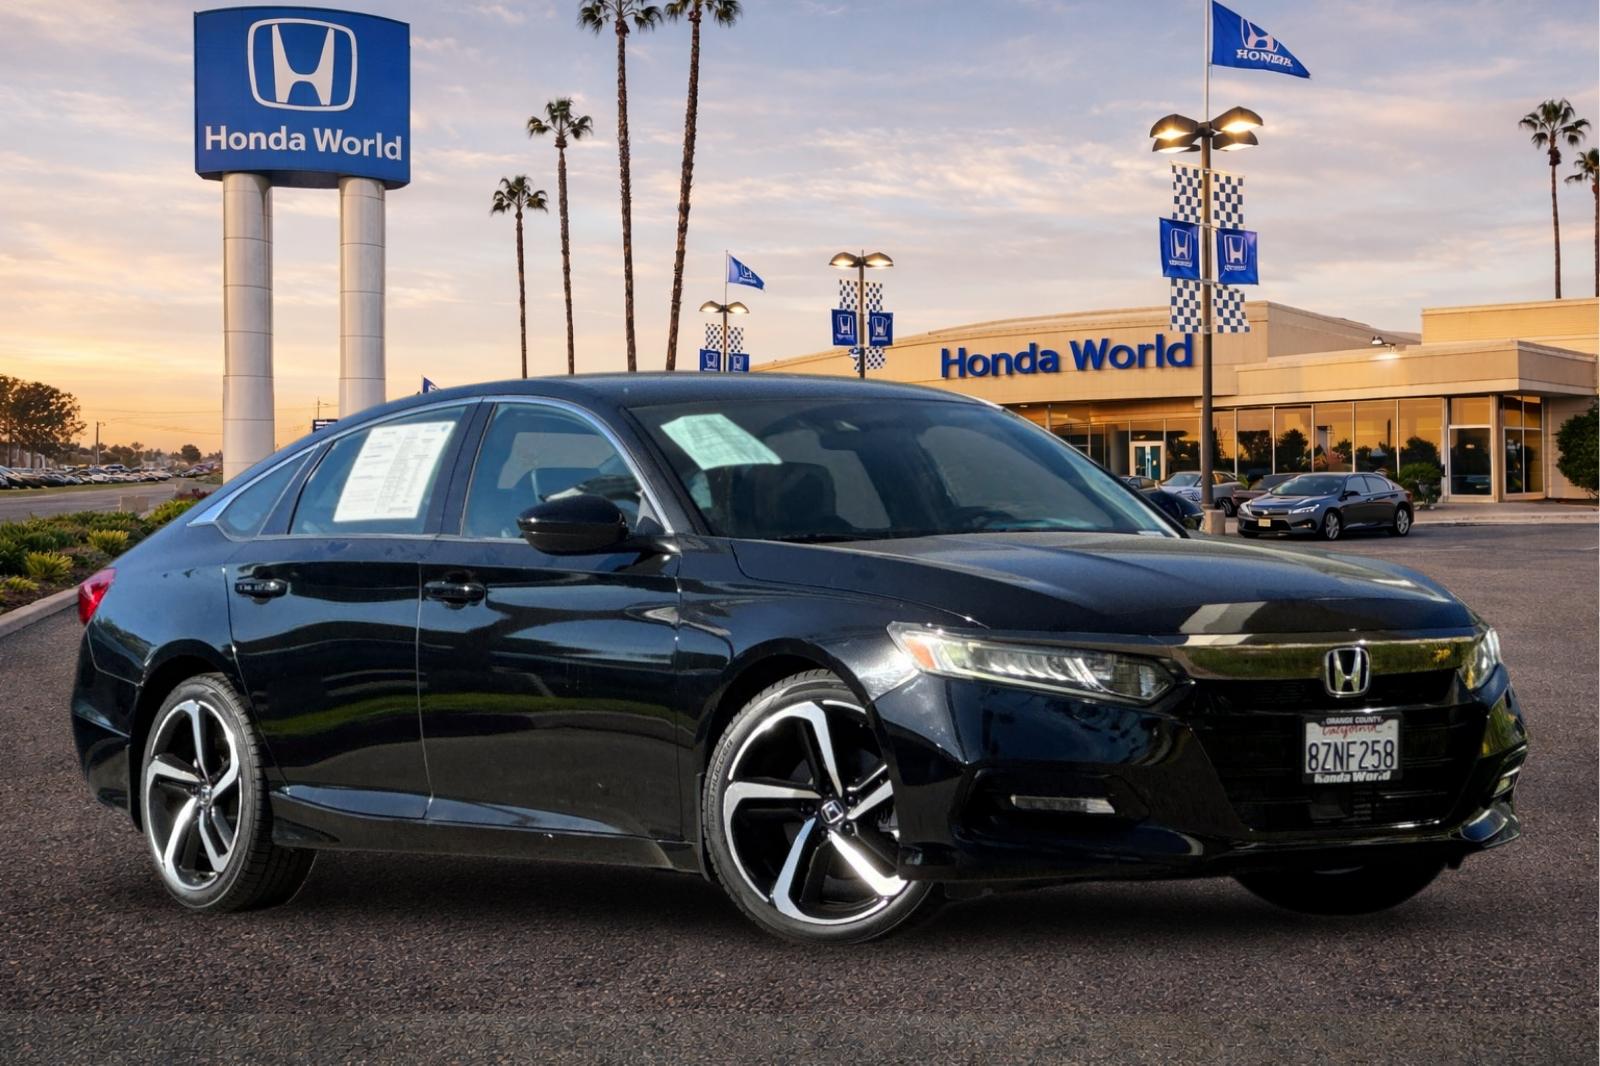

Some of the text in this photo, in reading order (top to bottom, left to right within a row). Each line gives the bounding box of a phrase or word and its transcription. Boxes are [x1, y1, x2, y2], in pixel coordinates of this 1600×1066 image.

[205, 125, 402, 161] Honda World
[941, 333, 1194, 379] Honda World
[1325, 715, 1381, 725] ORANGE COUNTY
[1308, 740, 1395, 772] 8ZNF258
